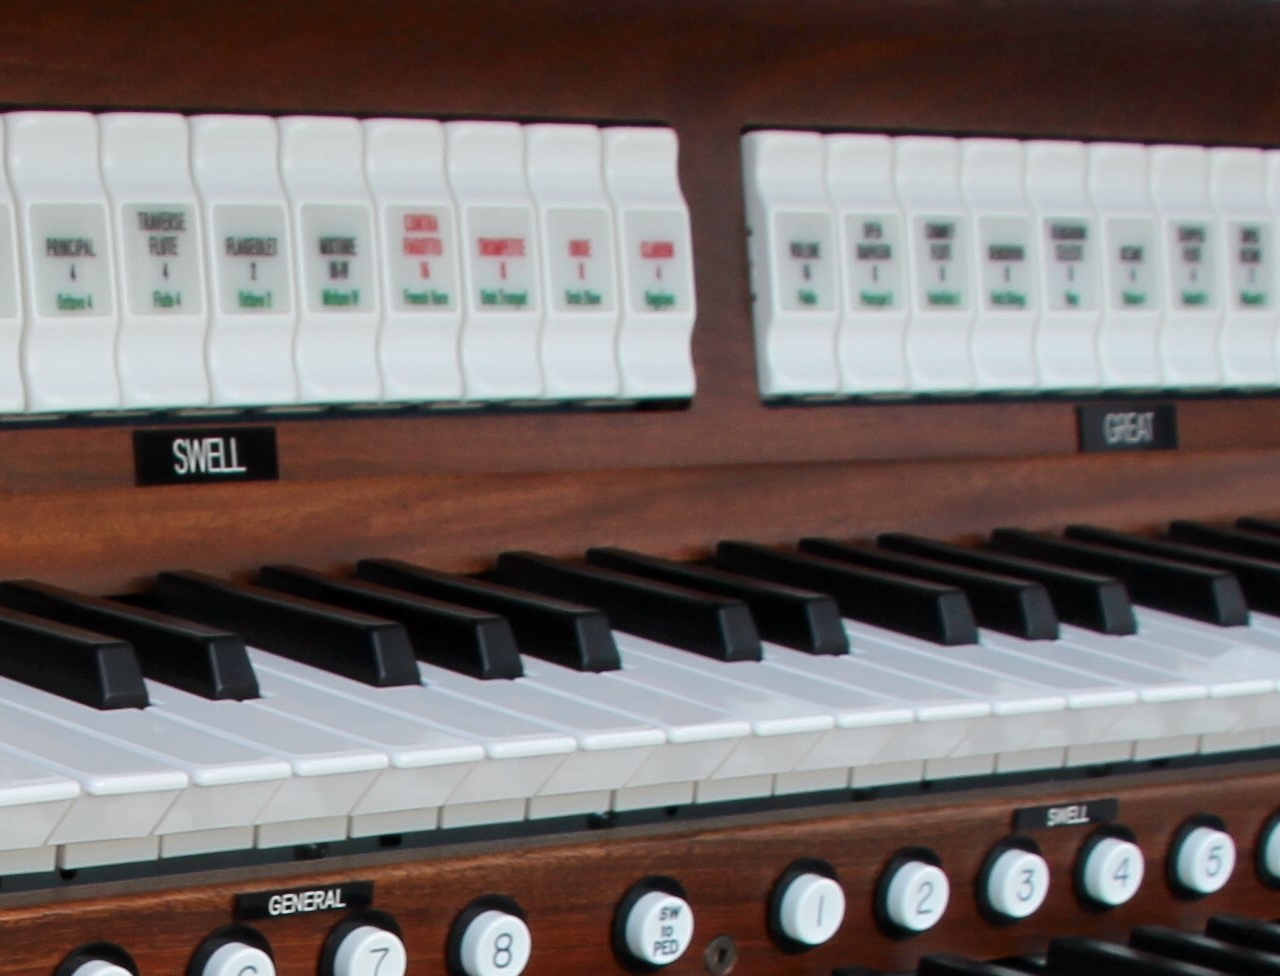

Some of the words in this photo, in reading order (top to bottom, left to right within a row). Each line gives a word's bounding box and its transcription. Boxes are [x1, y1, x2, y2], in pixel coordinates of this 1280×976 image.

[172, 436, 248, 475] SWELL
[1046, 805, 1091, 827] SWELL
[1113, 857, 1130, 888] 4
[1205, 846, 1223, 877] 5
[916, 881, 934, 915] 2
[1016, 869, 1035, 902] 3
[268, 888, 347, 917] GENERAL
[659, 905, 683, 921] SW
[816, 894, 825, 928] 1
[492, 932, 513, 969] 8
[652, 938, 679, 957] PED
